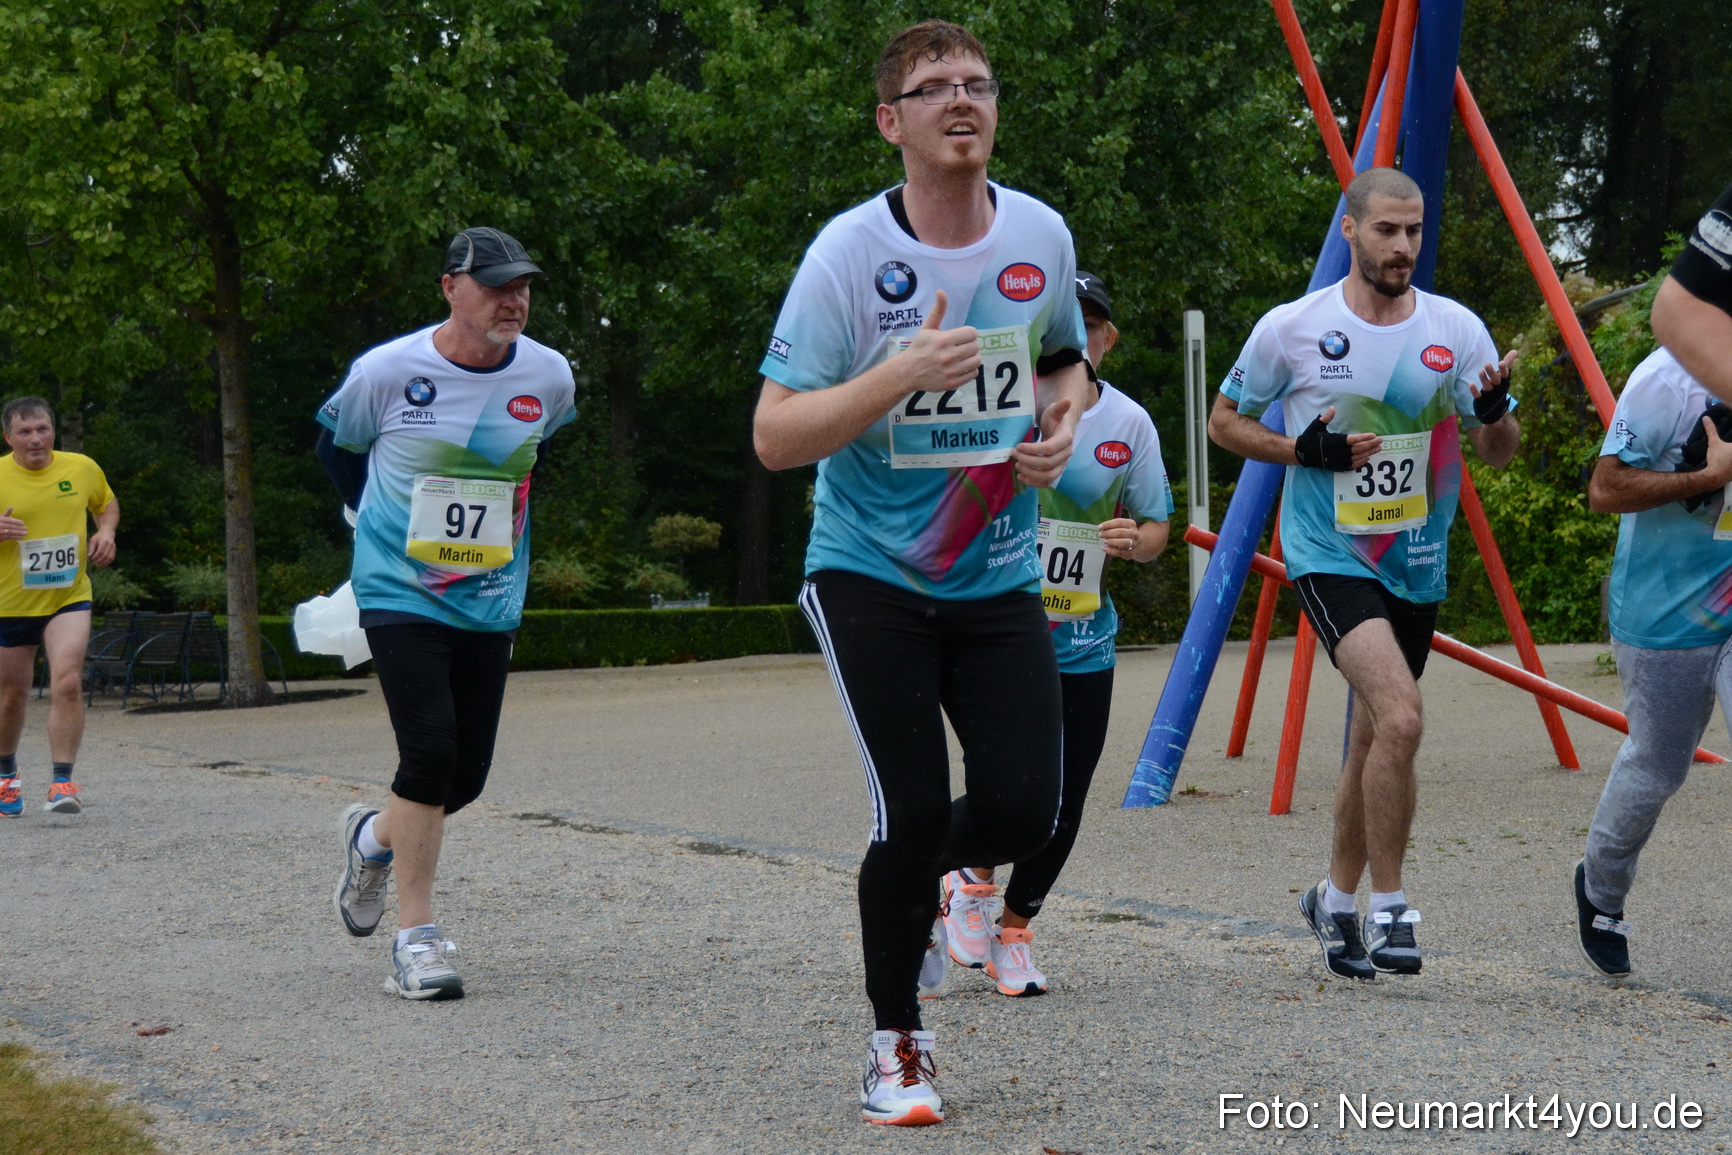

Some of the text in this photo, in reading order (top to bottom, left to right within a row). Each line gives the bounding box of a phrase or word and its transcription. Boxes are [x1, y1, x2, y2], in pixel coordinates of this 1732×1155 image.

[876, 262, 911, 277] BMW
[1004, 273, 1041, 291] Hervis
[878, 308, 923, 323] PARTL
[879, 319, 923, 332] Neumarkt
[1320, 365, 1353, 374] PARTL
[408, 378, 434, 388] BMW
[402, 410, 437, 420] PARTL
[513, 401, 541, 416] Hervis
[402, 418, 437, 426] Neumarkt
[895, 415, 901, 423] D
[931, 428, 1000, 449] Markus
[1381, 437, 1424, 451] BOCK
[1100, 447, 1127, 462] Hervis
[1355, 458, 1415, 498] 332
[421, 487, 456, 495] NeuerMarkt
[461, 482, 507, 497] BOCK
[1367, 503, 1404, 522] Jamal
[445, 502, 488, 539] 97
[992, 514, 1013, 539] 17.
[1057, 524, 1102, 541] BOCK
[1406, 527, 1426, 543] 17.
[29, 547, 75, 571] 2796
[439, 547, 483, 563] Martin
[1041, 595, 1071, 610] phia
